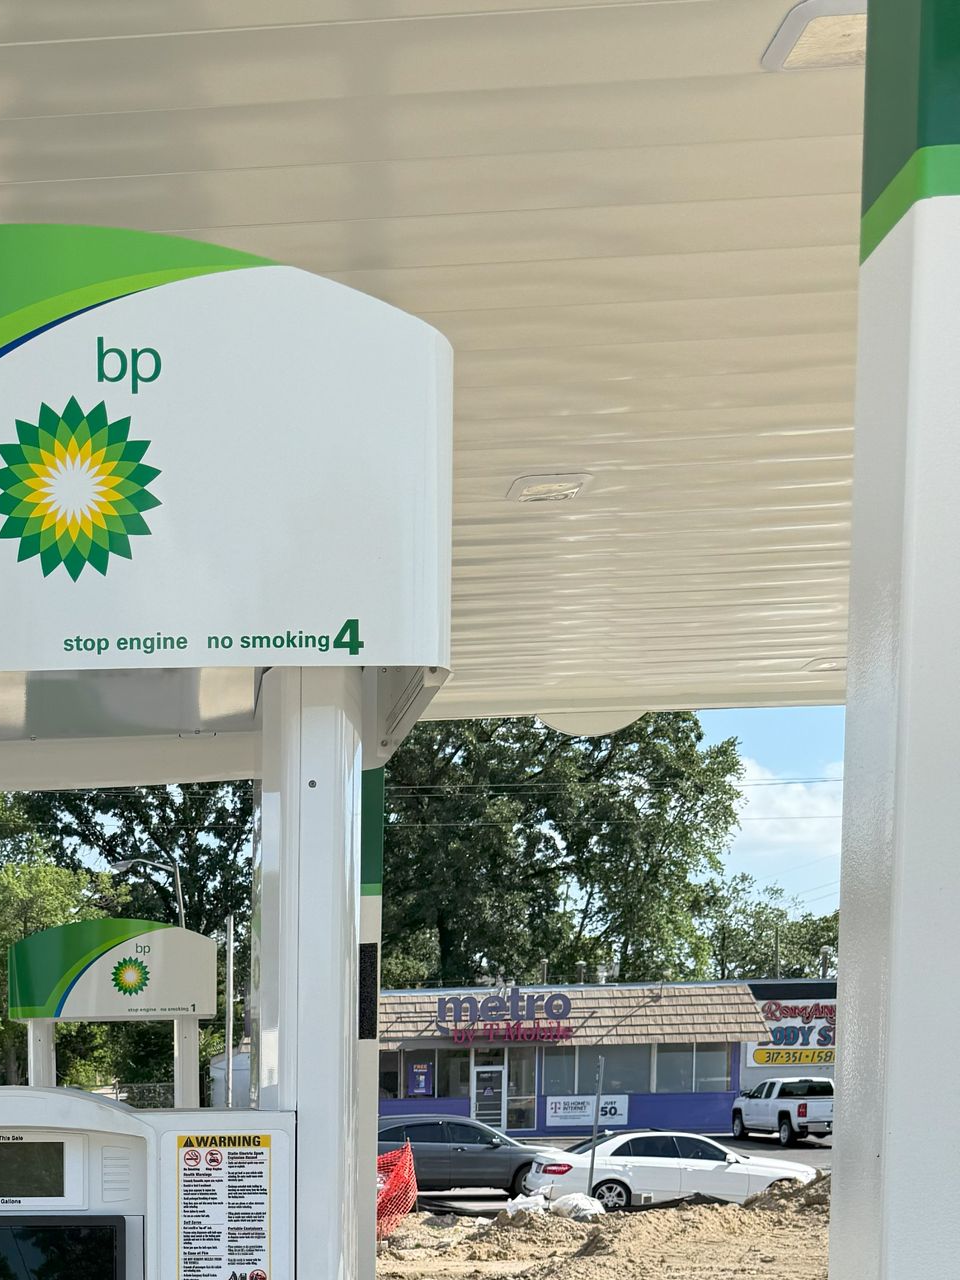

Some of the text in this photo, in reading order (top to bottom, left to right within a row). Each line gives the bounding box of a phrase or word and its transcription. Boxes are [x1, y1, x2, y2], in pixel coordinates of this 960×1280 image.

[97, 336, 162, 394] bp
[63, 619, 364, 655] stop engine no smoking 4
[135, 943, 151, 956] bp
[191, 1004, 196, 1012] 1
[437, 988, 572, 1022] metro
[452, 1026, 475, 1048] by
[503, 1020, 573, 1041] Mobile
[758, 1026, 816, 1046] ODY
[600, 1106, 618, 1116] 50
[195, 1136, 261, 1147] WARNING
